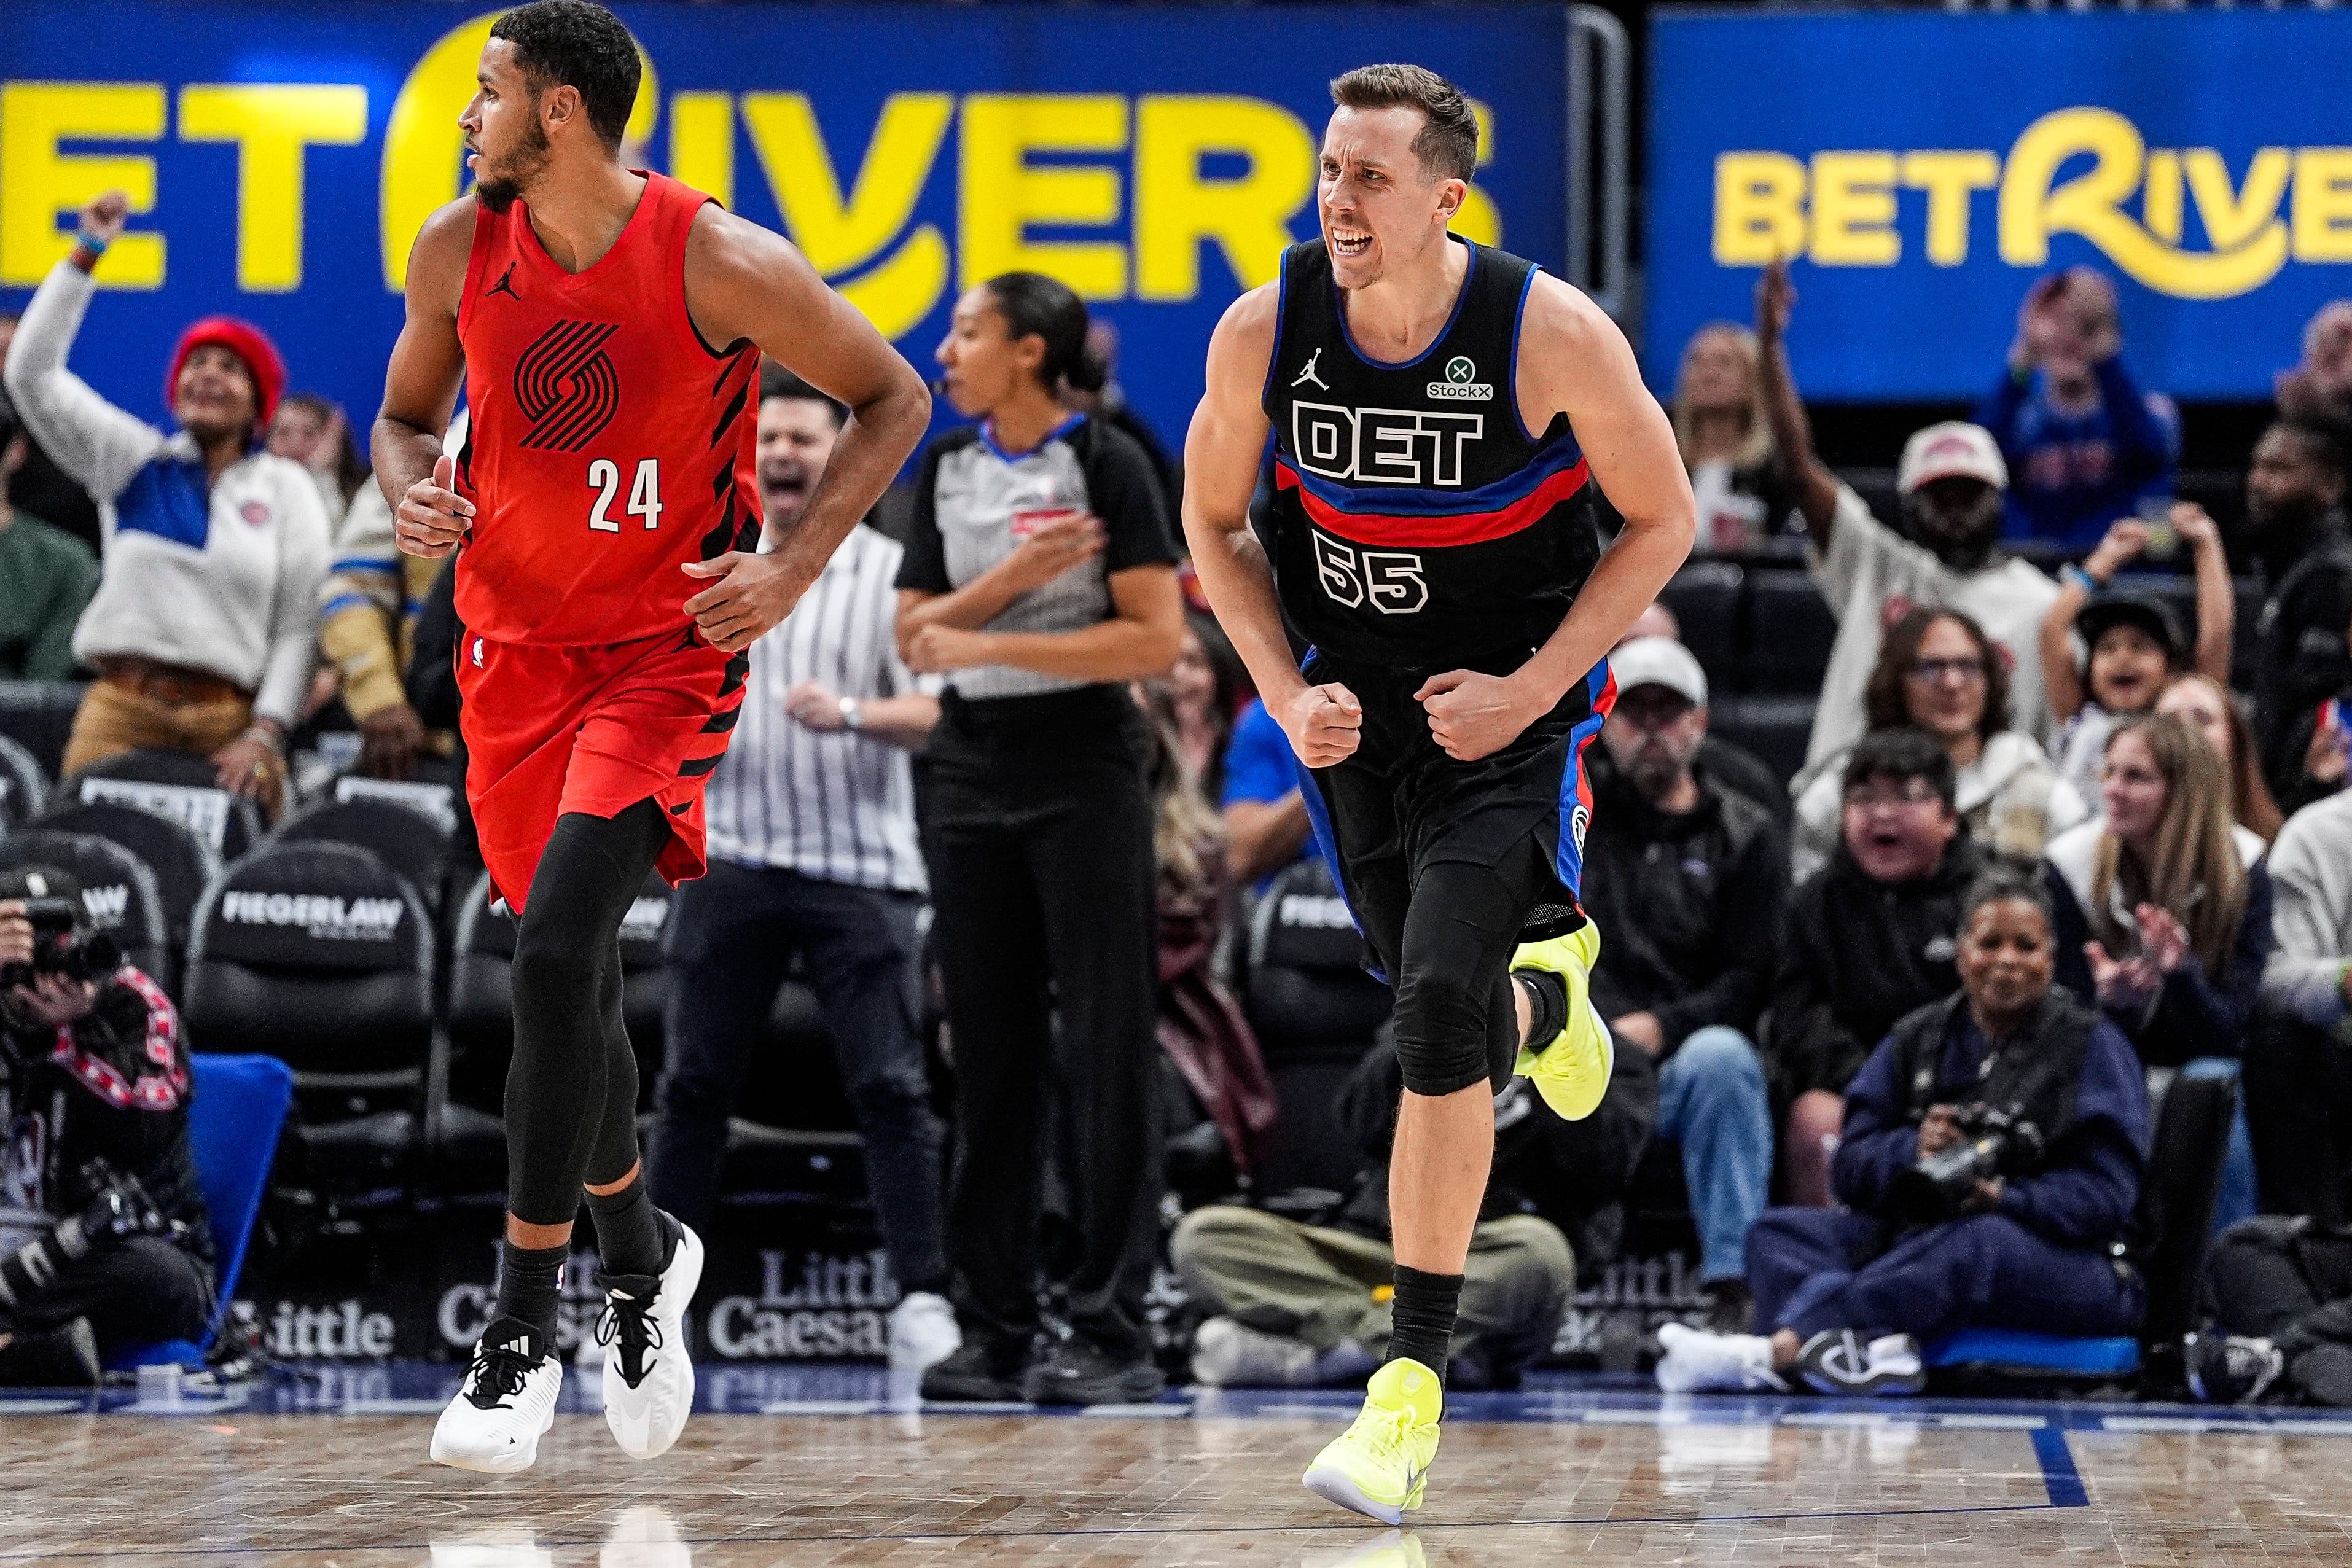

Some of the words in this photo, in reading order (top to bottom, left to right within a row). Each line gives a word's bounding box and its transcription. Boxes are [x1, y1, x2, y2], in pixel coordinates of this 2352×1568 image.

[1711, 105, 2352, 300] BETRIVE
[1429, 384, 1490, 398] StockX
[1292, 400, 1483, 485] DET
[587, 458, 663, 533] 24
[1311, 529, 1429, 614] 55
[708, 1295, 891, 1357] Caesa
